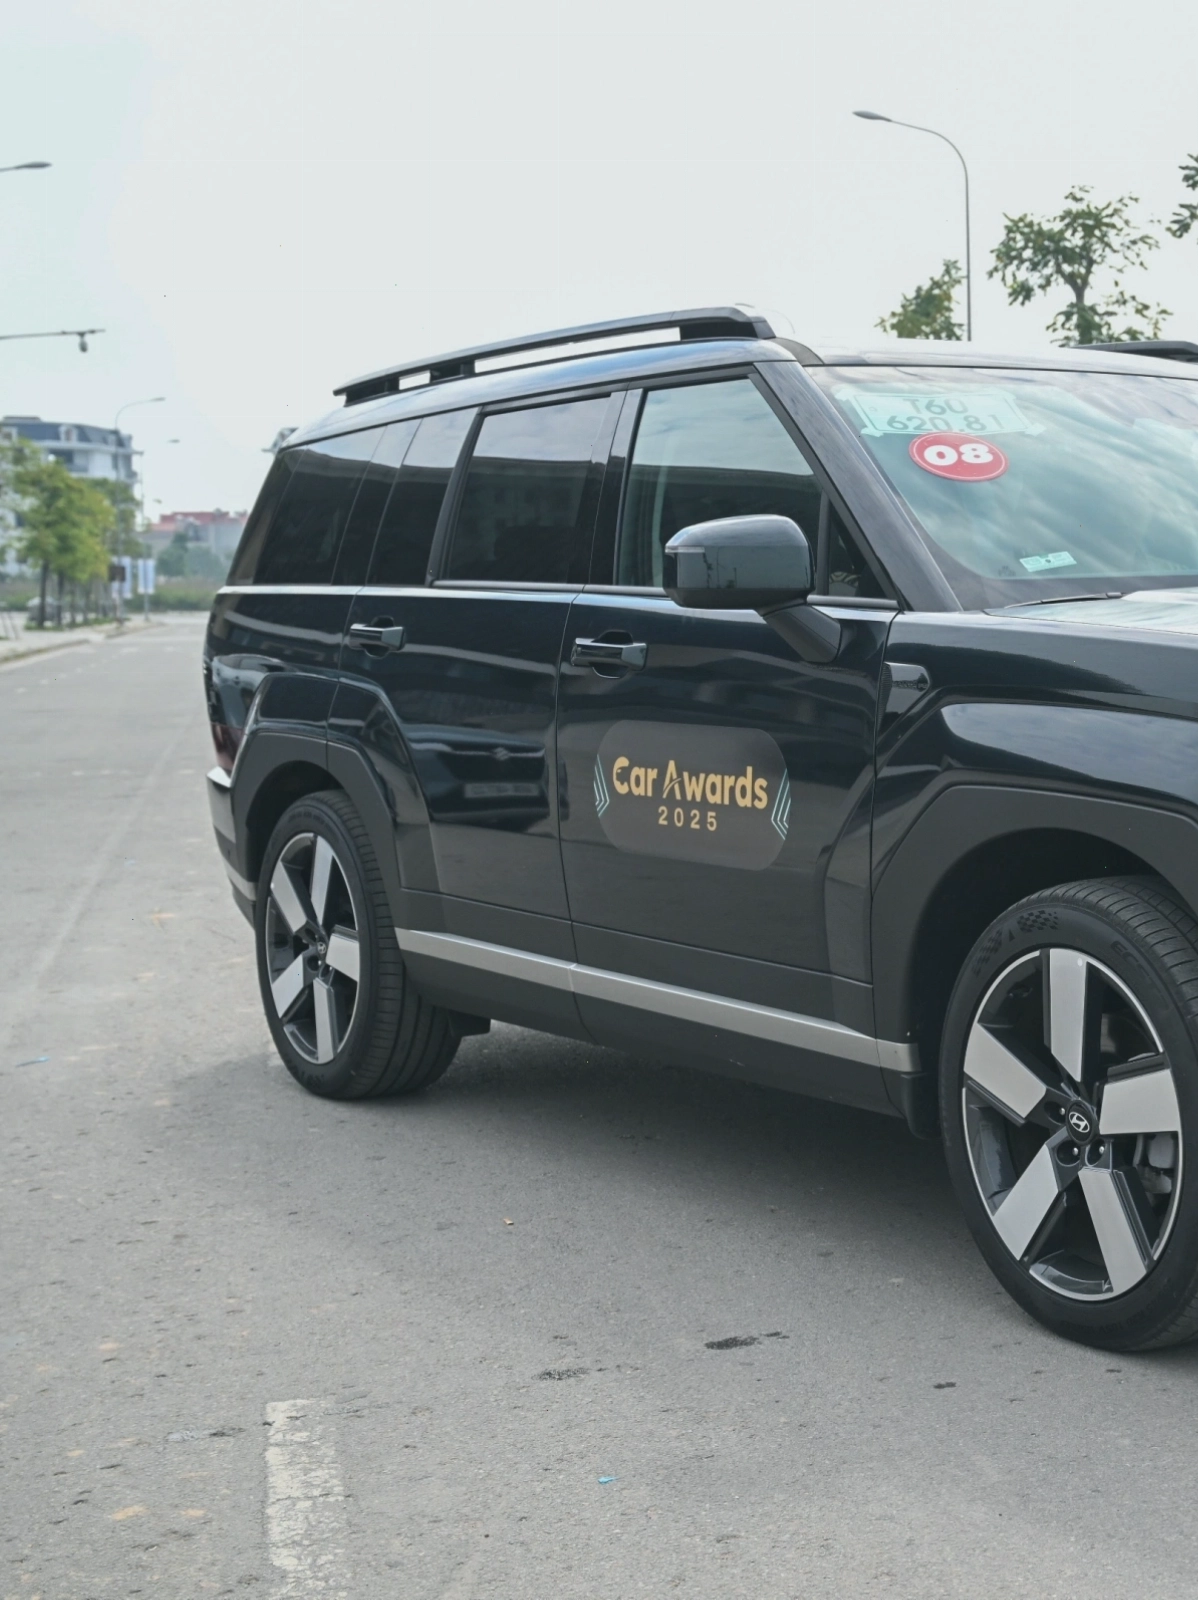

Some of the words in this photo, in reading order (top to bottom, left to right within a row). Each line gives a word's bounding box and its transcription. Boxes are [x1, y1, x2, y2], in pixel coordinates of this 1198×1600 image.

[902, 397, 969, 415] T60
[886, 414, 1005, 432] 620.81
[923, 443, 993, 466] 08
[612, 756, 658, 797] Car
[662, 759, 769, 810] Awards
[657, 805, 717, 831] 2025
